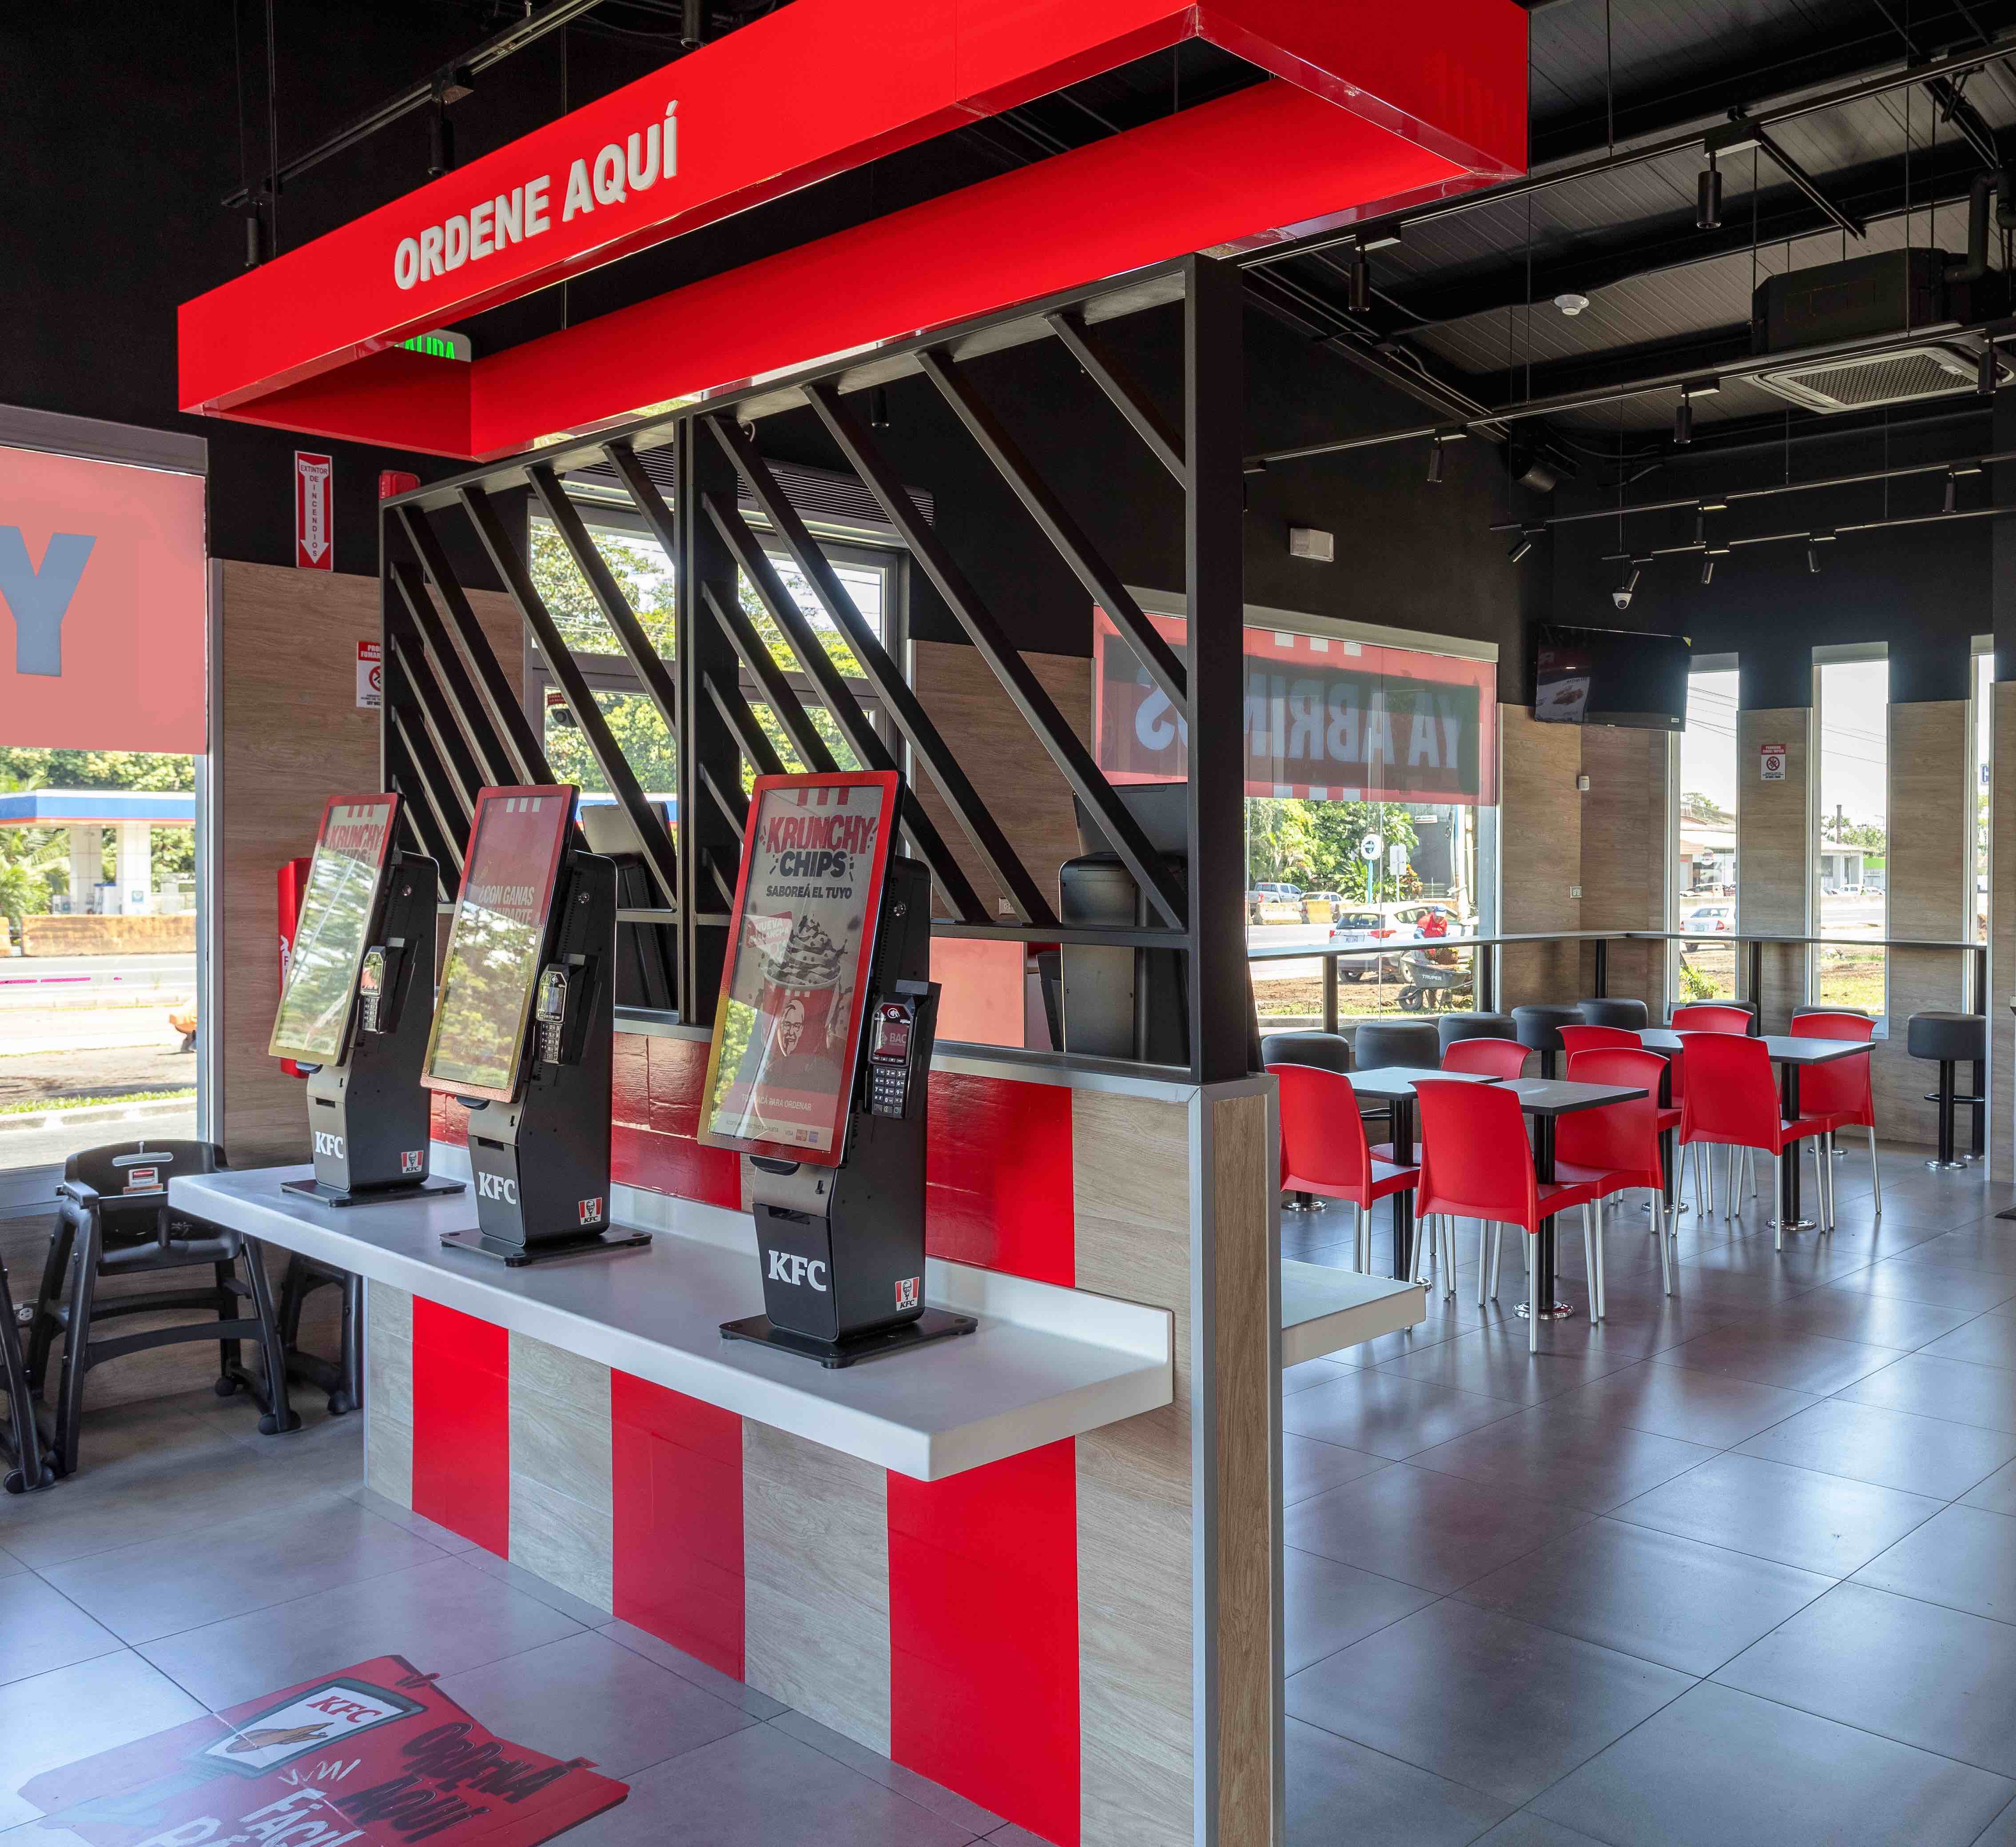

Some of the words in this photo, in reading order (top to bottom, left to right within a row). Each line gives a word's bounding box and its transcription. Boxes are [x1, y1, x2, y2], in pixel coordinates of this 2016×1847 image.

[394, 175, 551, 290] ORDENE
[562, 99, 679, 222] AQUÍ
[301, 465, 328, 474] EXTINTOR
[327, 824, 385, 851] KRUNCHY
[766, 815, 877, 854] KRUNCHY
[779, 851, 847, 878] CHIPS
[503, 886, 535, 906] GANAS
[766, 883, 810, 898] SABOREÁ
[811, 886, 823, 898] EL
[825, 887, 853, 900] TUYO
[890, 1032, 907, 1044] BAC
[769, 1097, 783, 1107] PARA
[784, 1099, 812, 1111] ORDENAR
[315, 1131, 344, 1159] KFC
[478, 1172, 517, 1205] KFC
[768, 1250, 827, 1291] KFC
[900, 1299, 915, 1309] KFC
[306, 1696, 382, 1723] KFC
